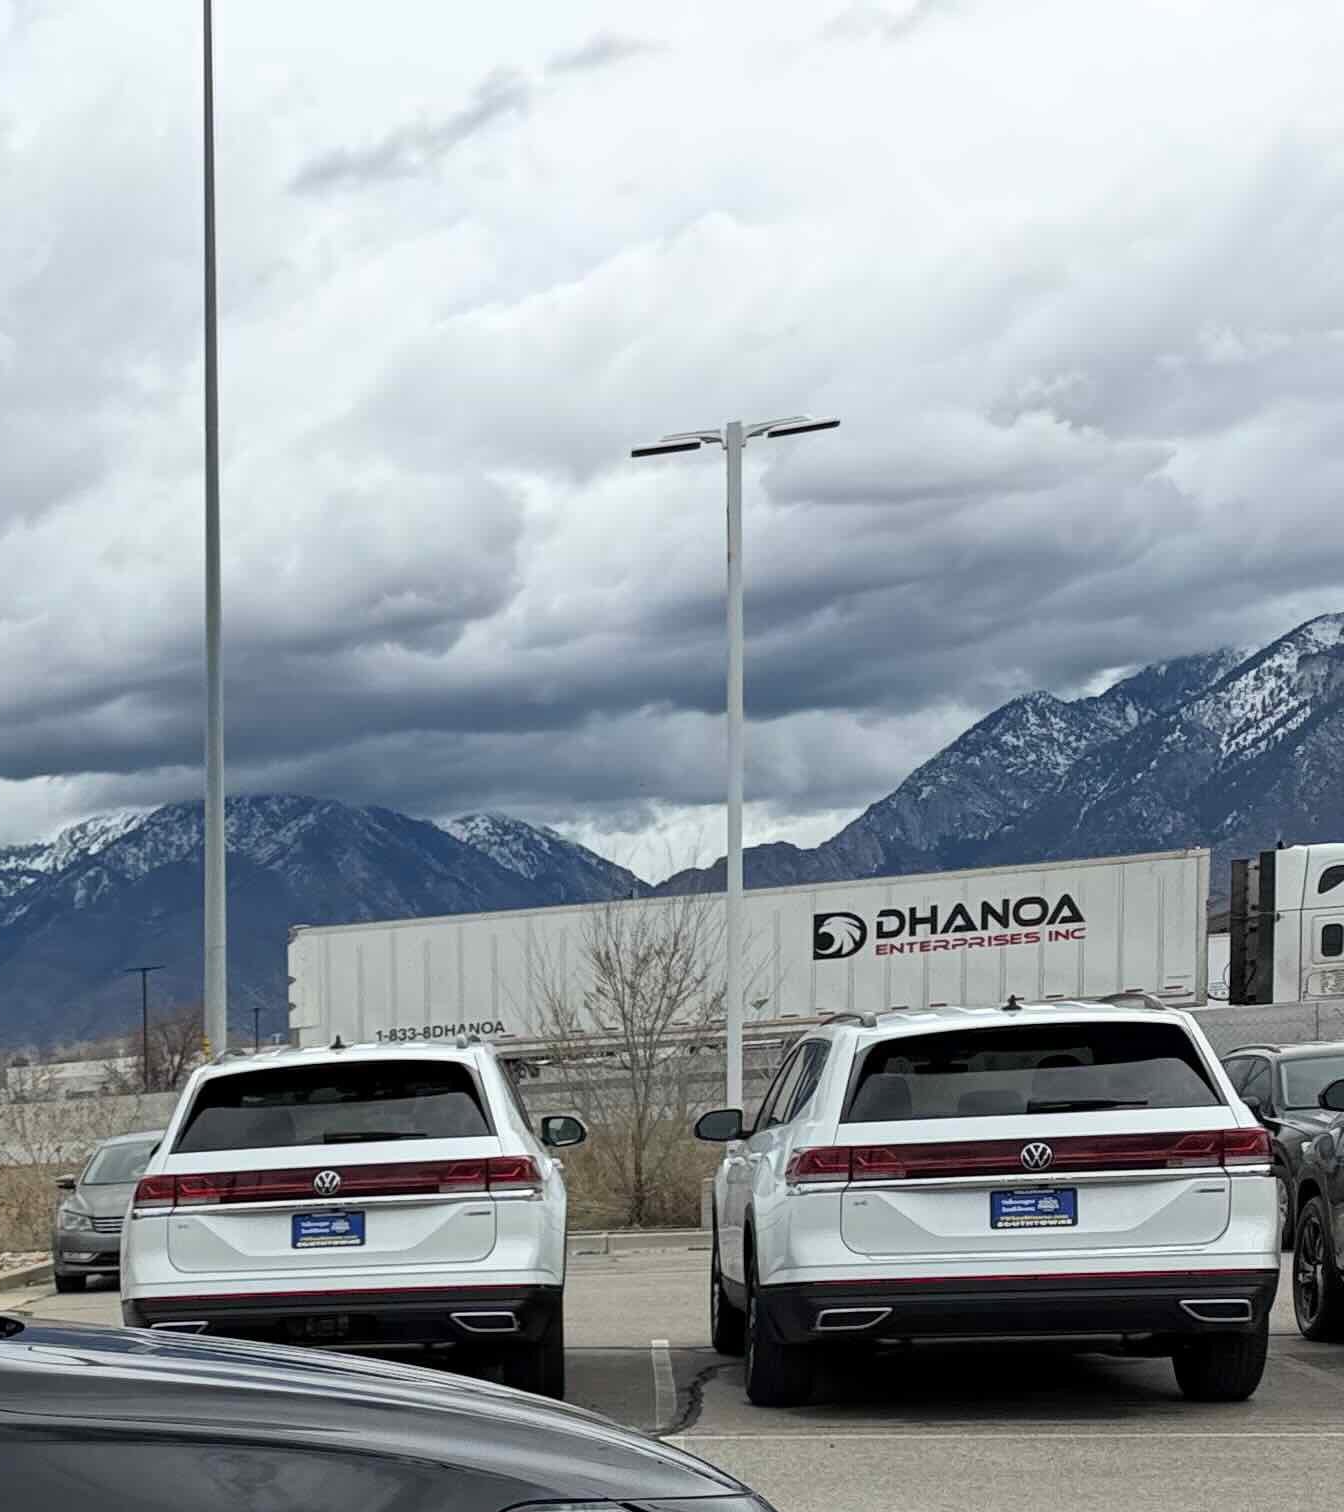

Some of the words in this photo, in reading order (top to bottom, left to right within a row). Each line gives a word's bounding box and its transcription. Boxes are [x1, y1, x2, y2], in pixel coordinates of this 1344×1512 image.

[875, 893, 1086, 940] DHANOA
[874, 931, 1041, 956] ENTERPRISES
[1048, 927, 1087, 943] INC
[375, 1020, 506, 1041] 1-833-8DHANOA
